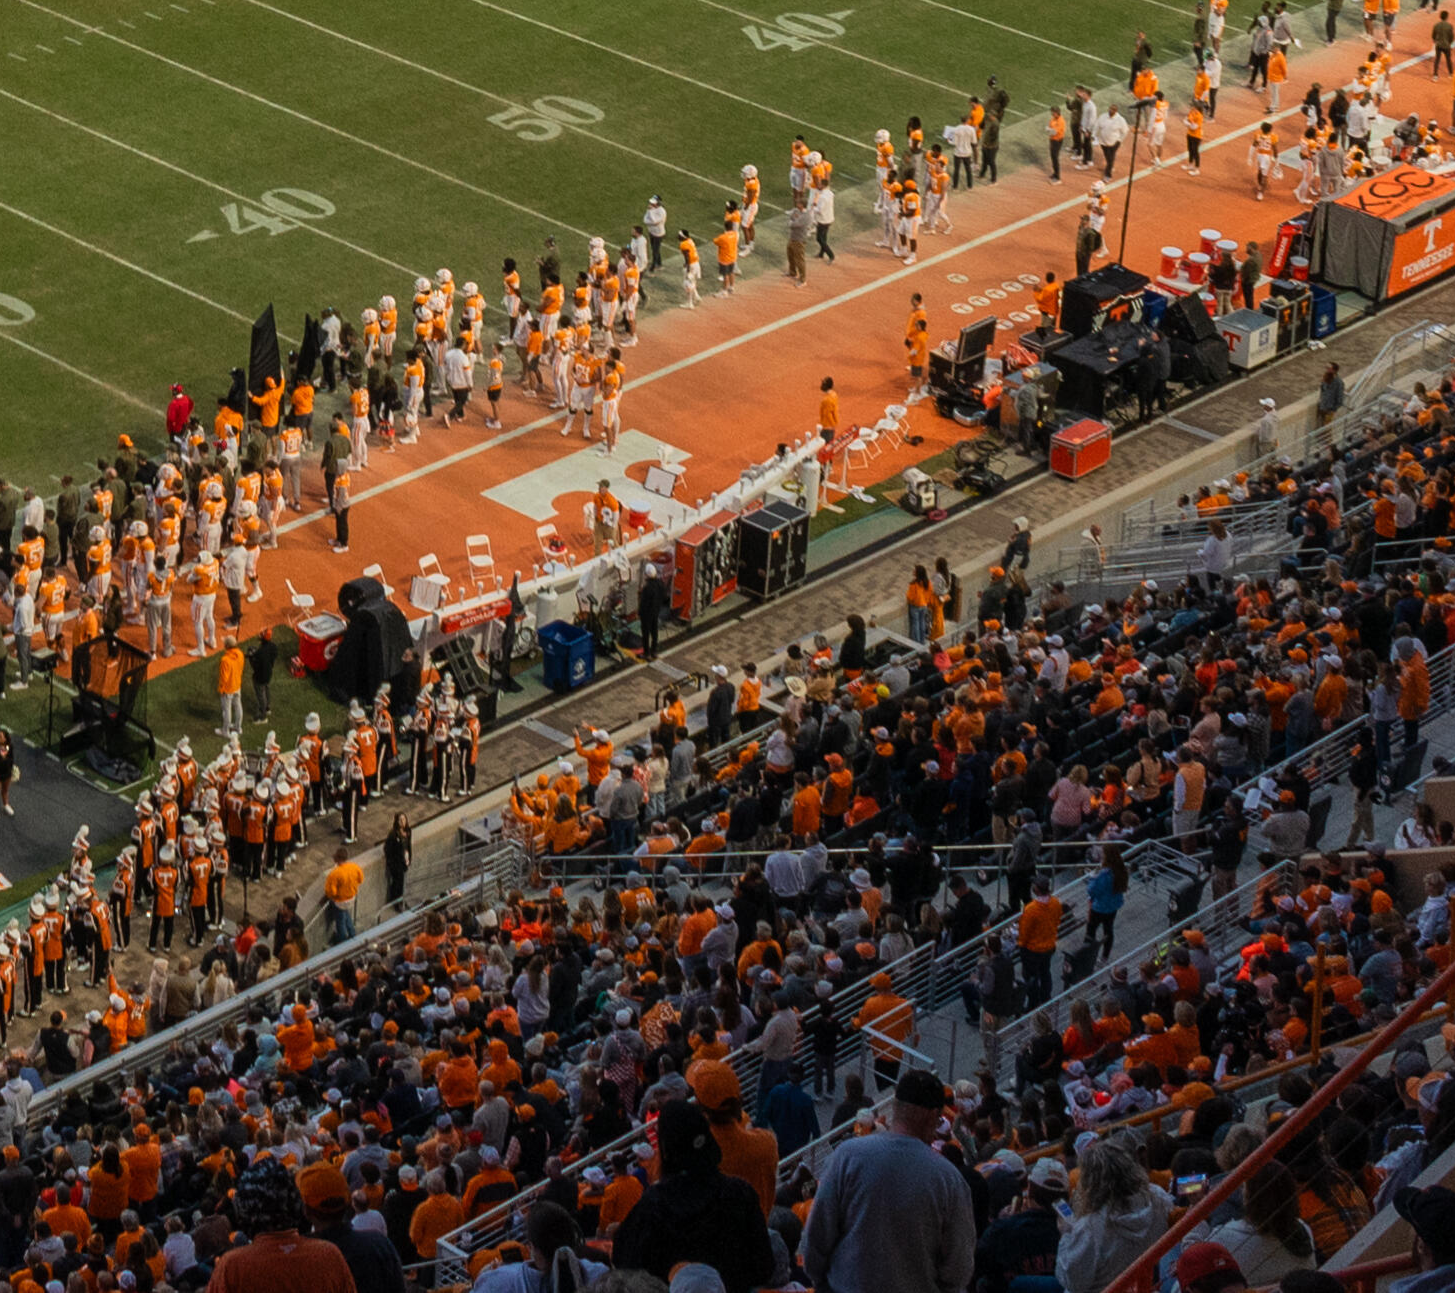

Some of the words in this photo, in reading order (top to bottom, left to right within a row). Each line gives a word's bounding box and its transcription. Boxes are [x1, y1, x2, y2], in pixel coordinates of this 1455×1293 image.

[741, 13, 846, 53] 40
[487, 95, 605, 142] 50
[220, 187, 336, 236] 40
[1424, 218, 1443, 253] T
